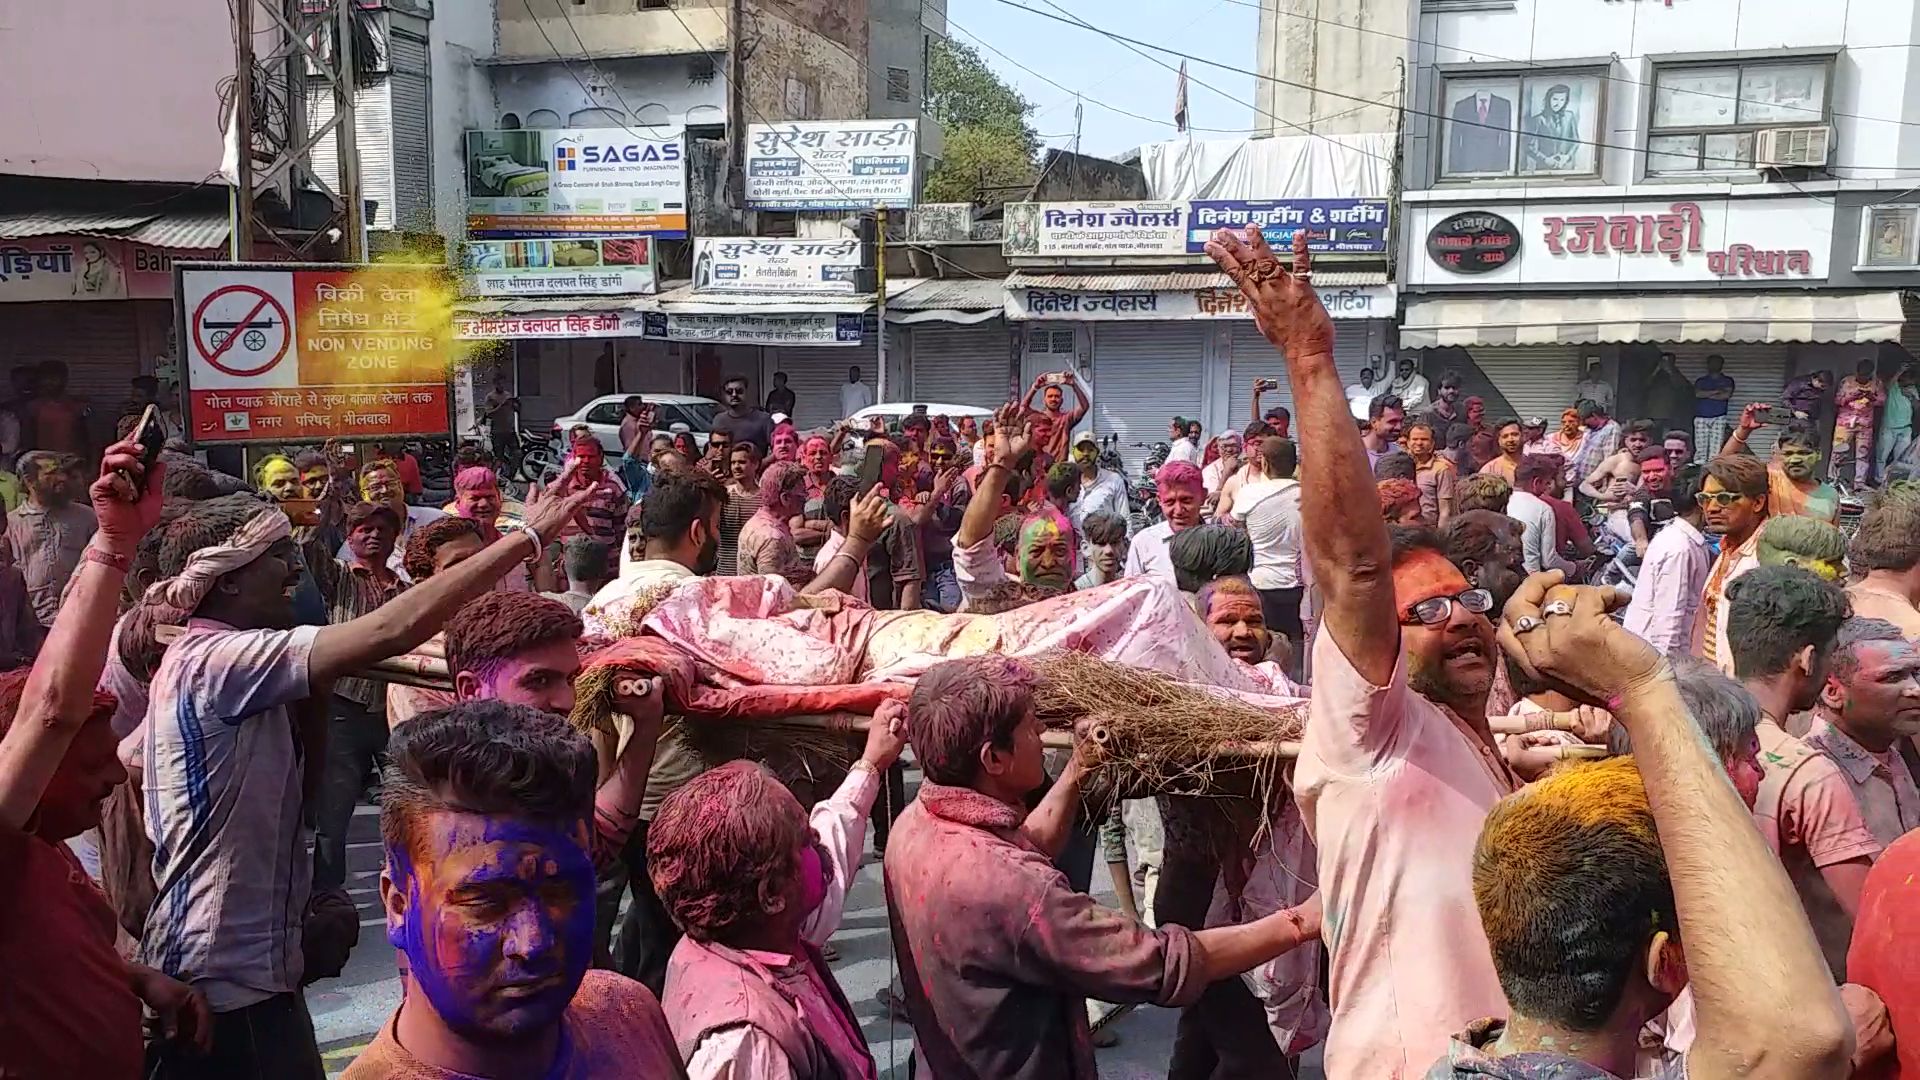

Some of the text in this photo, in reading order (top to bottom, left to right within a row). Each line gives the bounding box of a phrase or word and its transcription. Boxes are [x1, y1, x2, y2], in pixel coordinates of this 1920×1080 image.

[755, 122, 912, 155] सुरेश साड़ी
[583, 144, 680, 163] SAGAS
[1045, 208, 1106, 228] दिनेश
[1198, 207, 1249, 225] दिनेश
[1310, 207, 1326, 223] &
[1543, 202, 1704, 262] रजवाड़ी
[718, 239, 861, 260] सुरेश साड़ी
[1707, 243, 1811, 276] परिधान
[1026, 291, 1082, 314] दिनेश
[522, 318, 563, 332] दलपत
[308, 337, 433, 351] NON VENDING
[347, 355, 399, 369] ZONE
[205, 392, 232, 409] गोल
[236, 394, 263, 408] प्याऊ
[307, 391, 319, 406] से
[322, 394, 346, 410] मुख्य
[412, 391, 433, 405] तक
[256, 418, 283, 428] नगर
